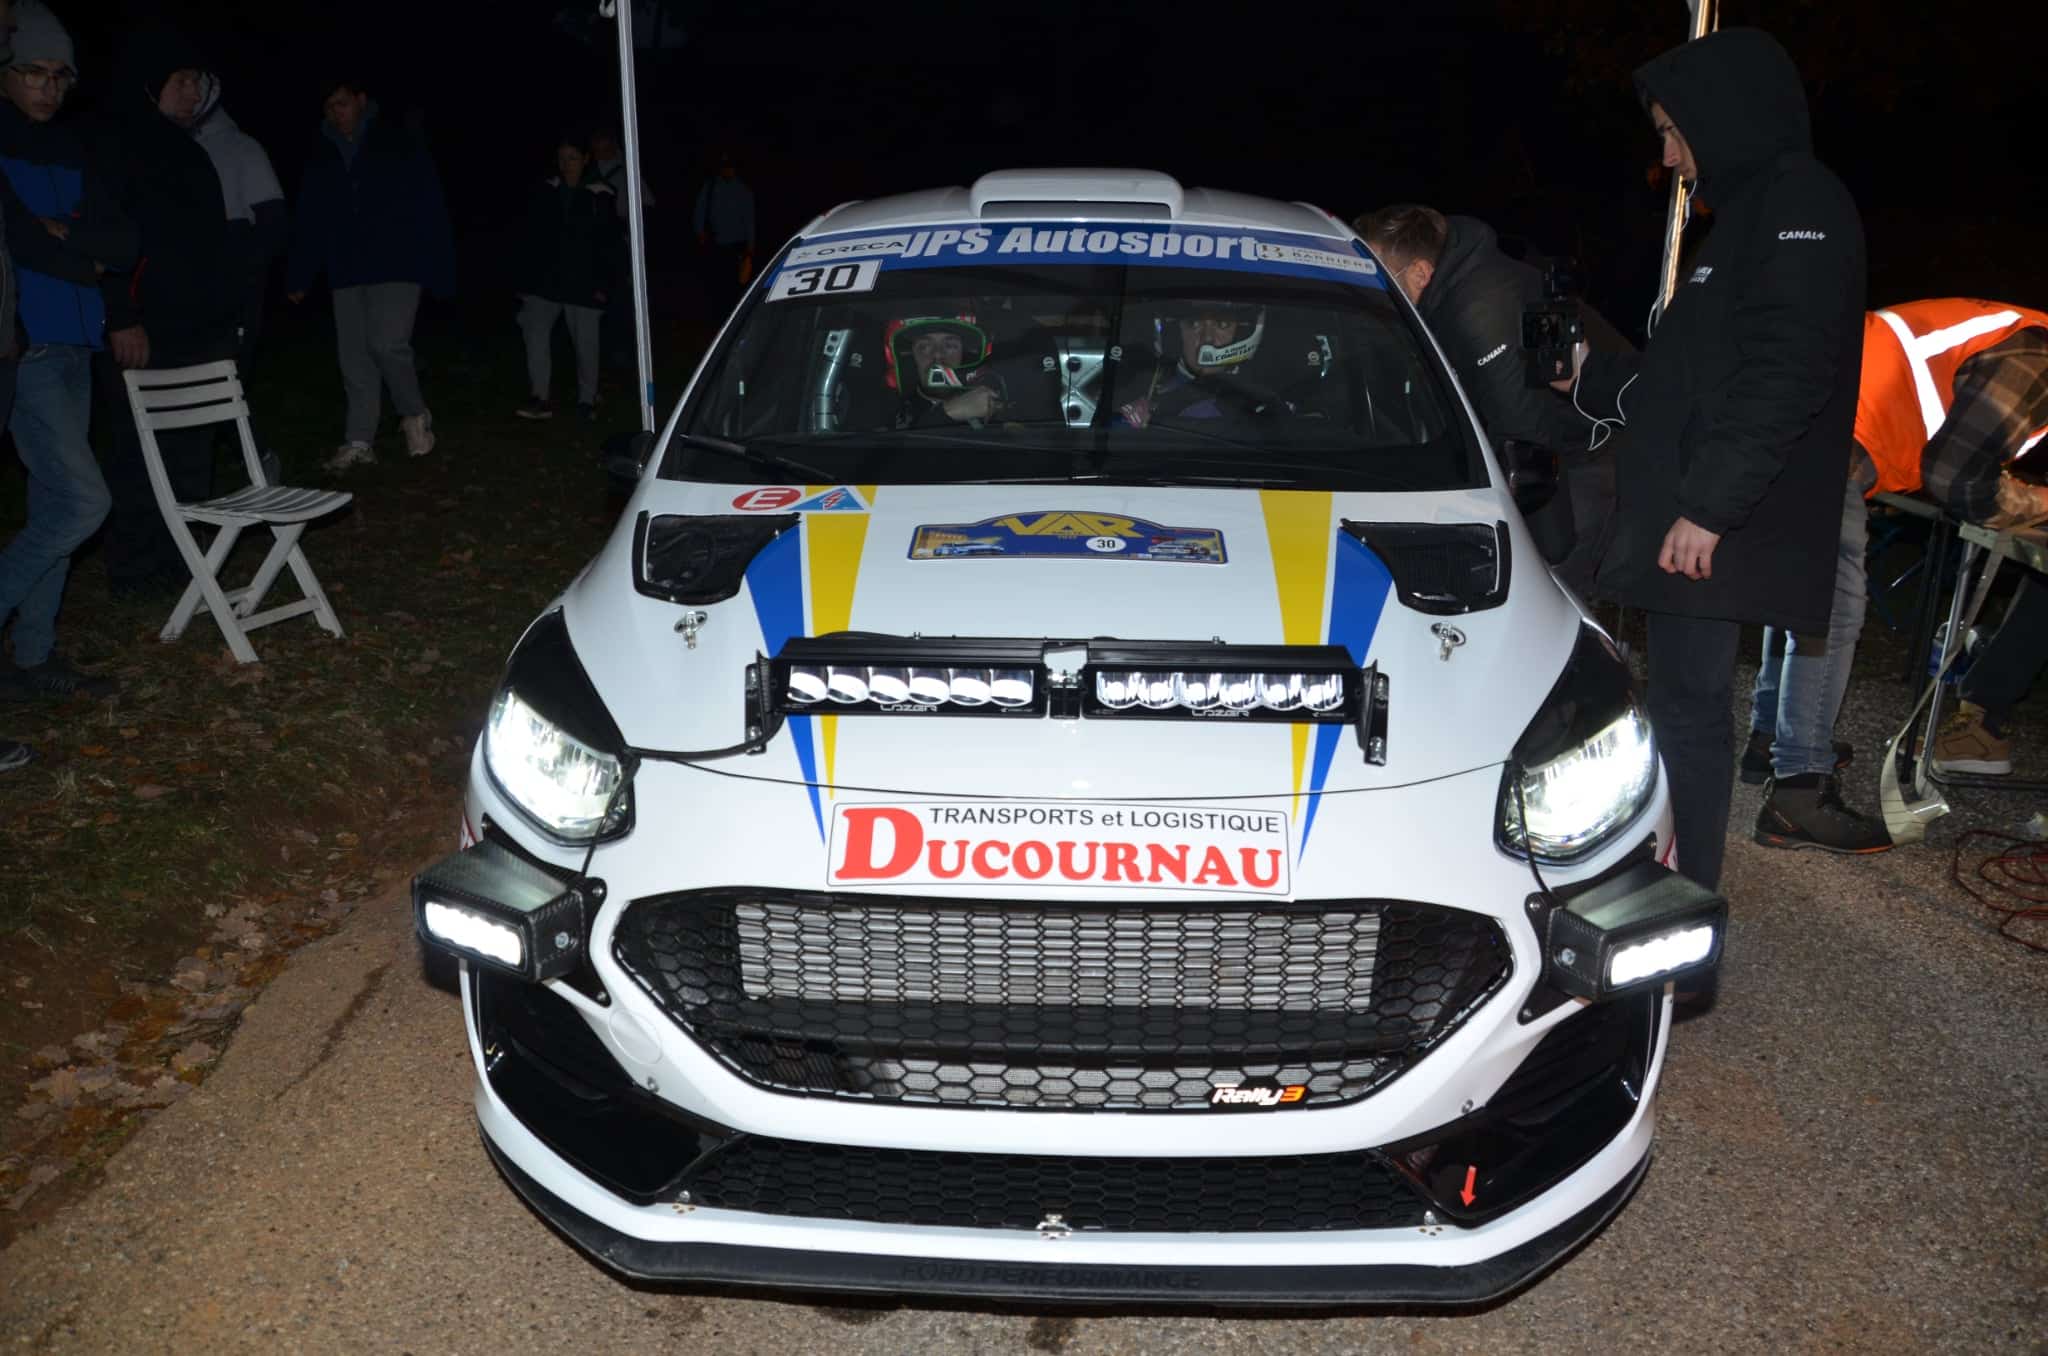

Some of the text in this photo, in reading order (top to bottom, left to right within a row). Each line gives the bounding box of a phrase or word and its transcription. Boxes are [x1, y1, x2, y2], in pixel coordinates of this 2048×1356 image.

[900, 227, 1258, 261] JPS Autosport
[1778, 230, 1827, 241] CANAL+
[816, 241, 905, 256] ORECA
[787, 263, 861, 296] 30
[1477, 343, 1508, 367] CANAL+
[992, 510, 1145, 538] VAR
[1095, 538, 1116, 550] 30
[929, 807, 1281, 833] TRANSPORTS et LOGISTIQUE
[1211, 1084, 1306, 1106] Rally3
[899, 1261, 1202, 1290] FORD PERFORMANCE
